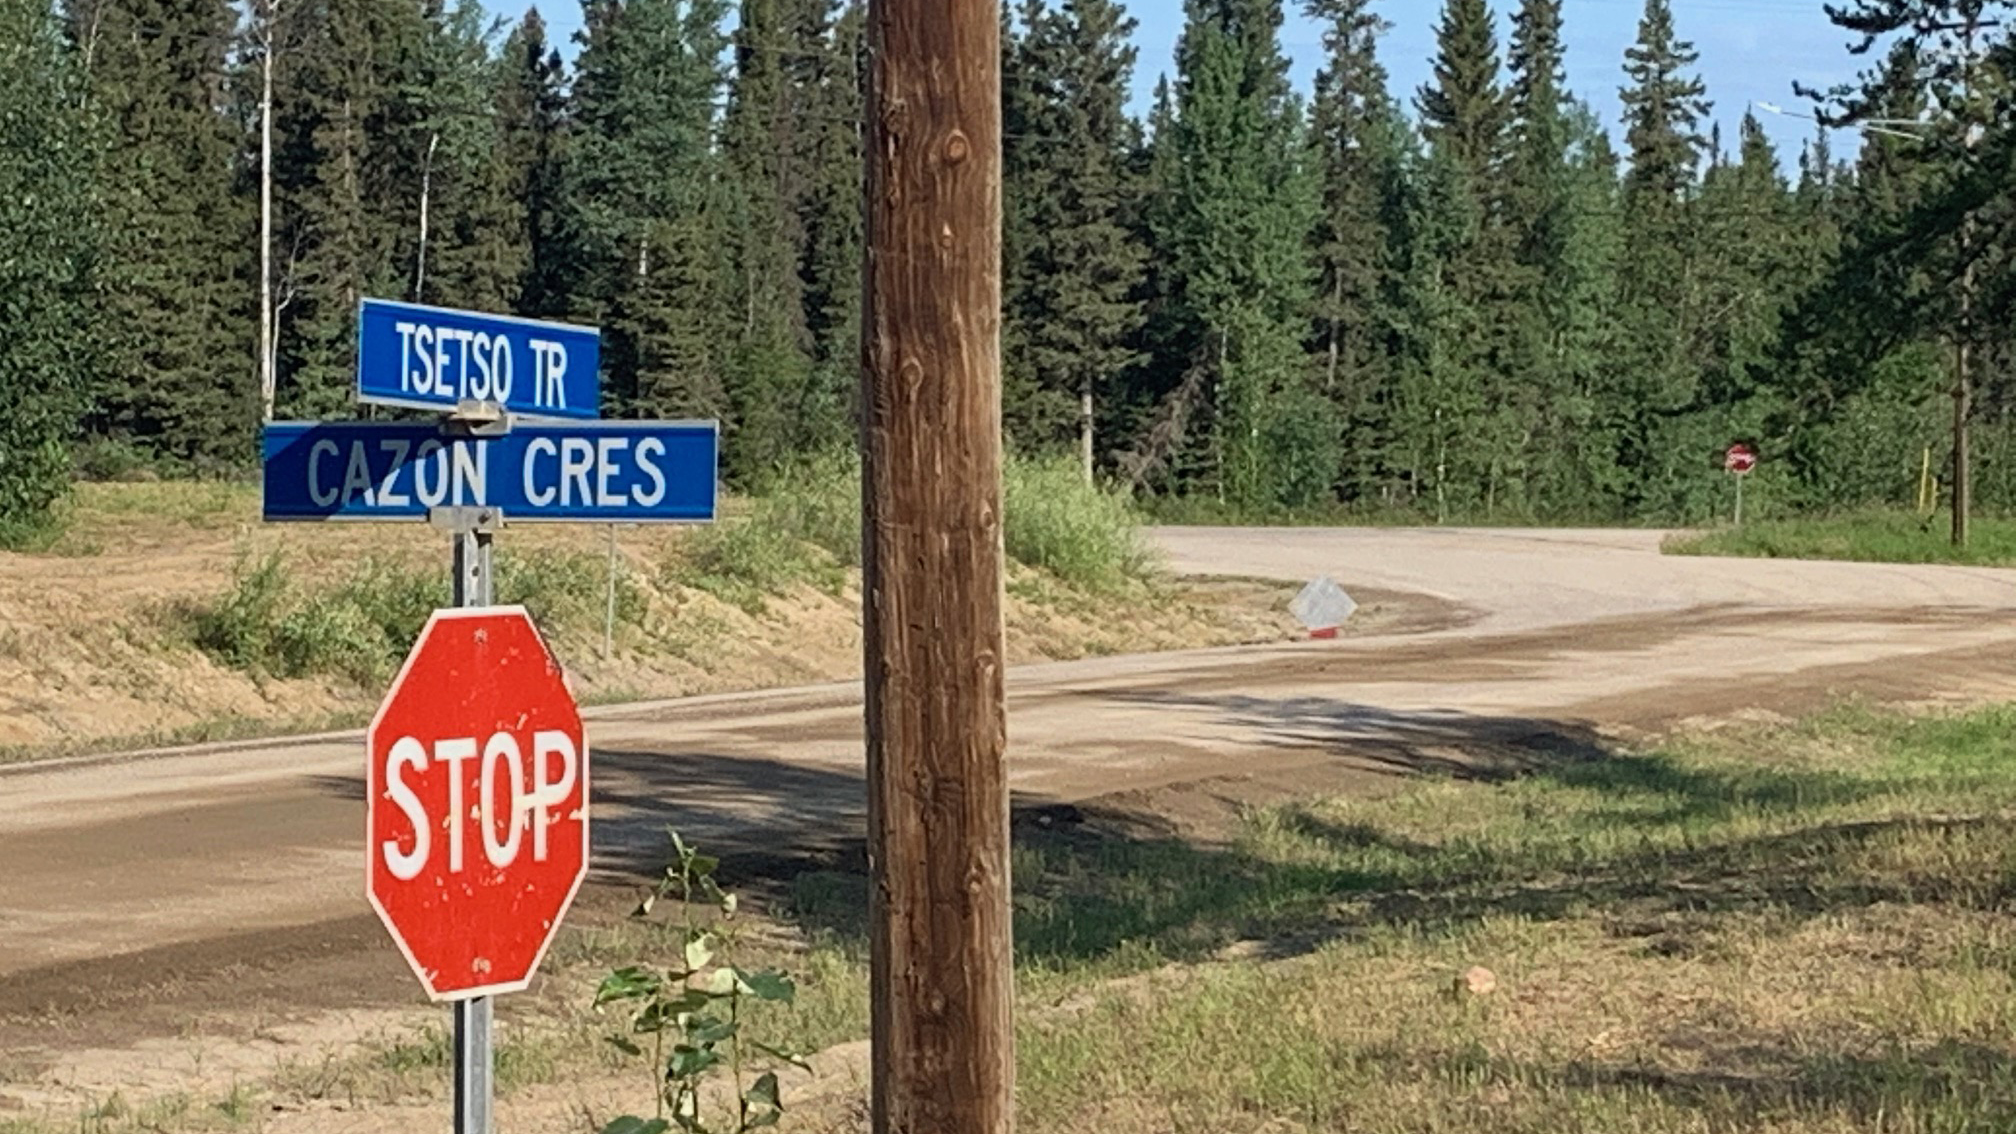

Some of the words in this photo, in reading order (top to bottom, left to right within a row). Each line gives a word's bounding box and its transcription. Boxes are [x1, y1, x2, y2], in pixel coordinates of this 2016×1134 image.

[396, 322, 513, 404] TSETSO
[529, 339, 569, 410] TR
[308, 438, 488, 508] CAZON
[523, 436, 667, 508] CRES
[382, 730, 577, 881] STOP
